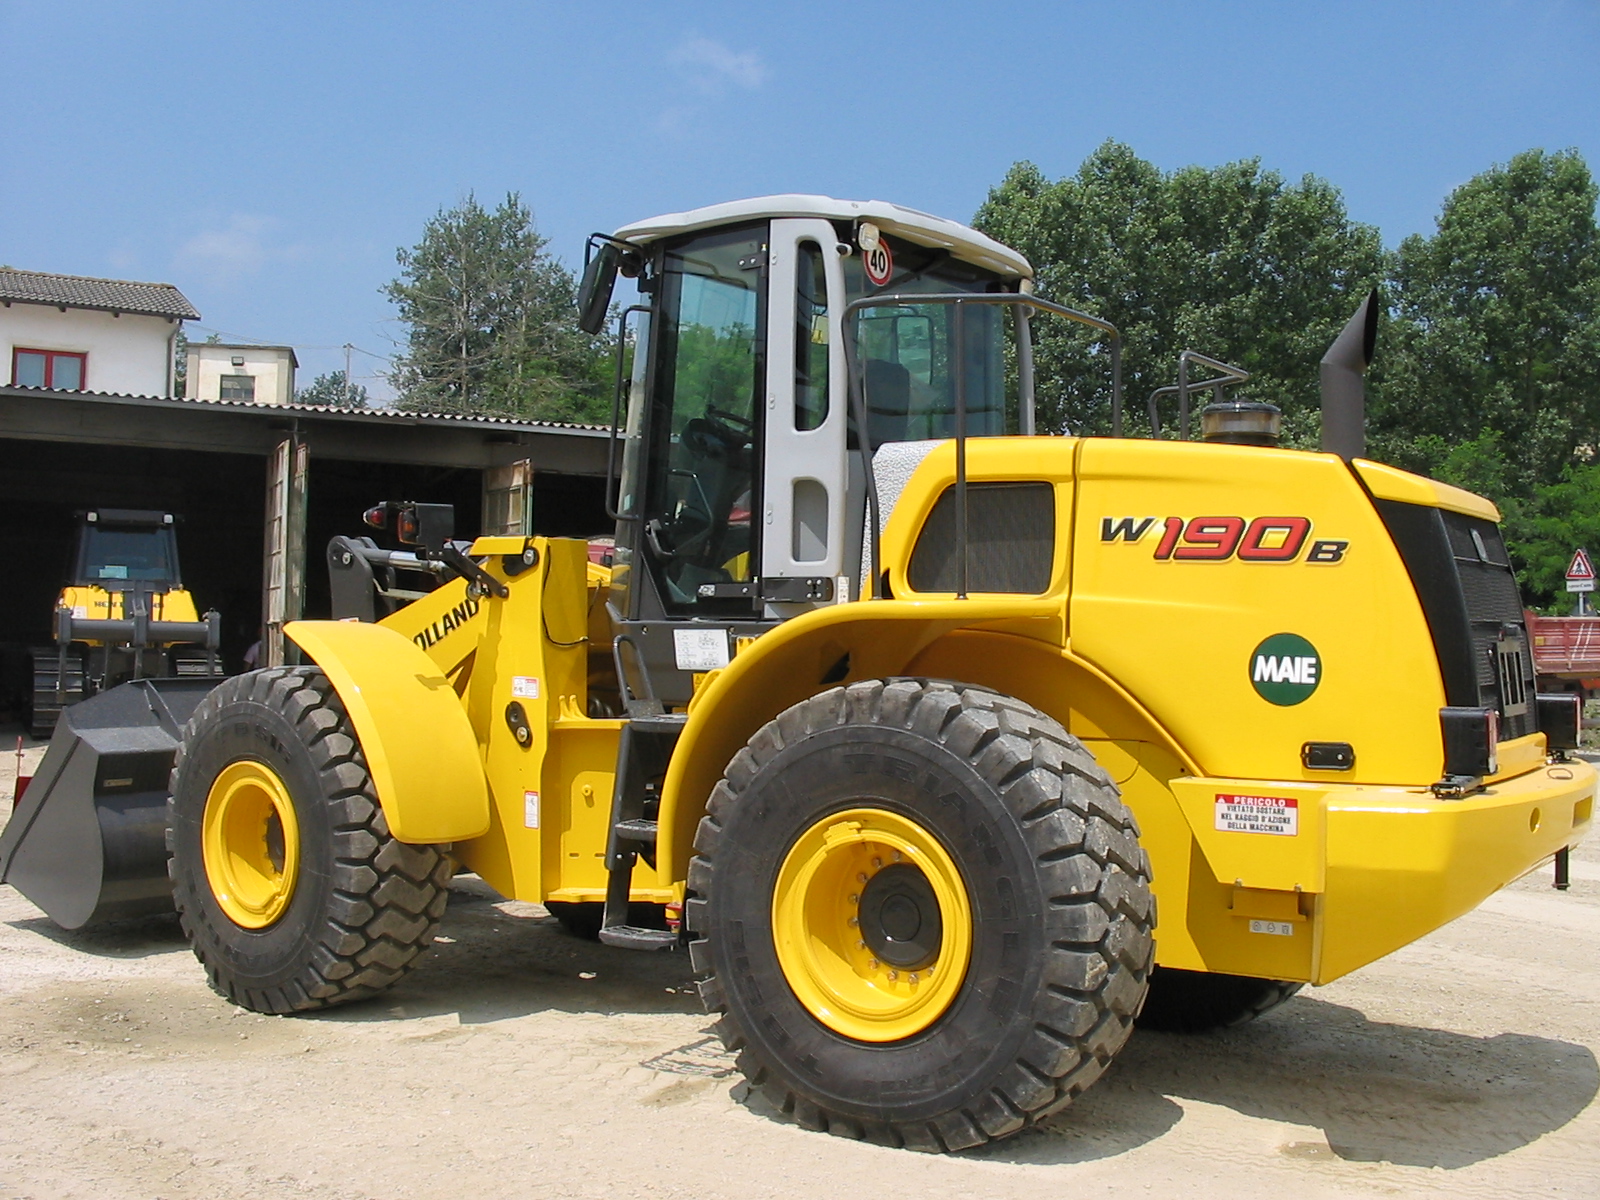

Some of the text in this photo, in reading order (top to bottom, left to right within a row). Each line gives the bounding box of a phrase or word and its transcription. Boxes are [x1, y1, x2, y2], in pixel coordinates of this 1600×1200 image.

[871, 249, 886, 272] 40
[1254, 654, 1317, 685] MAIE
[1233, 796, 1286, 807] PERICOLO
[1227, 805, 1286, 815] VIETATO SOSTARE
[1235, 814, 1259, 822] RAGGIO
[1227, 822, 1284, 832] DELLA MACCHINA
